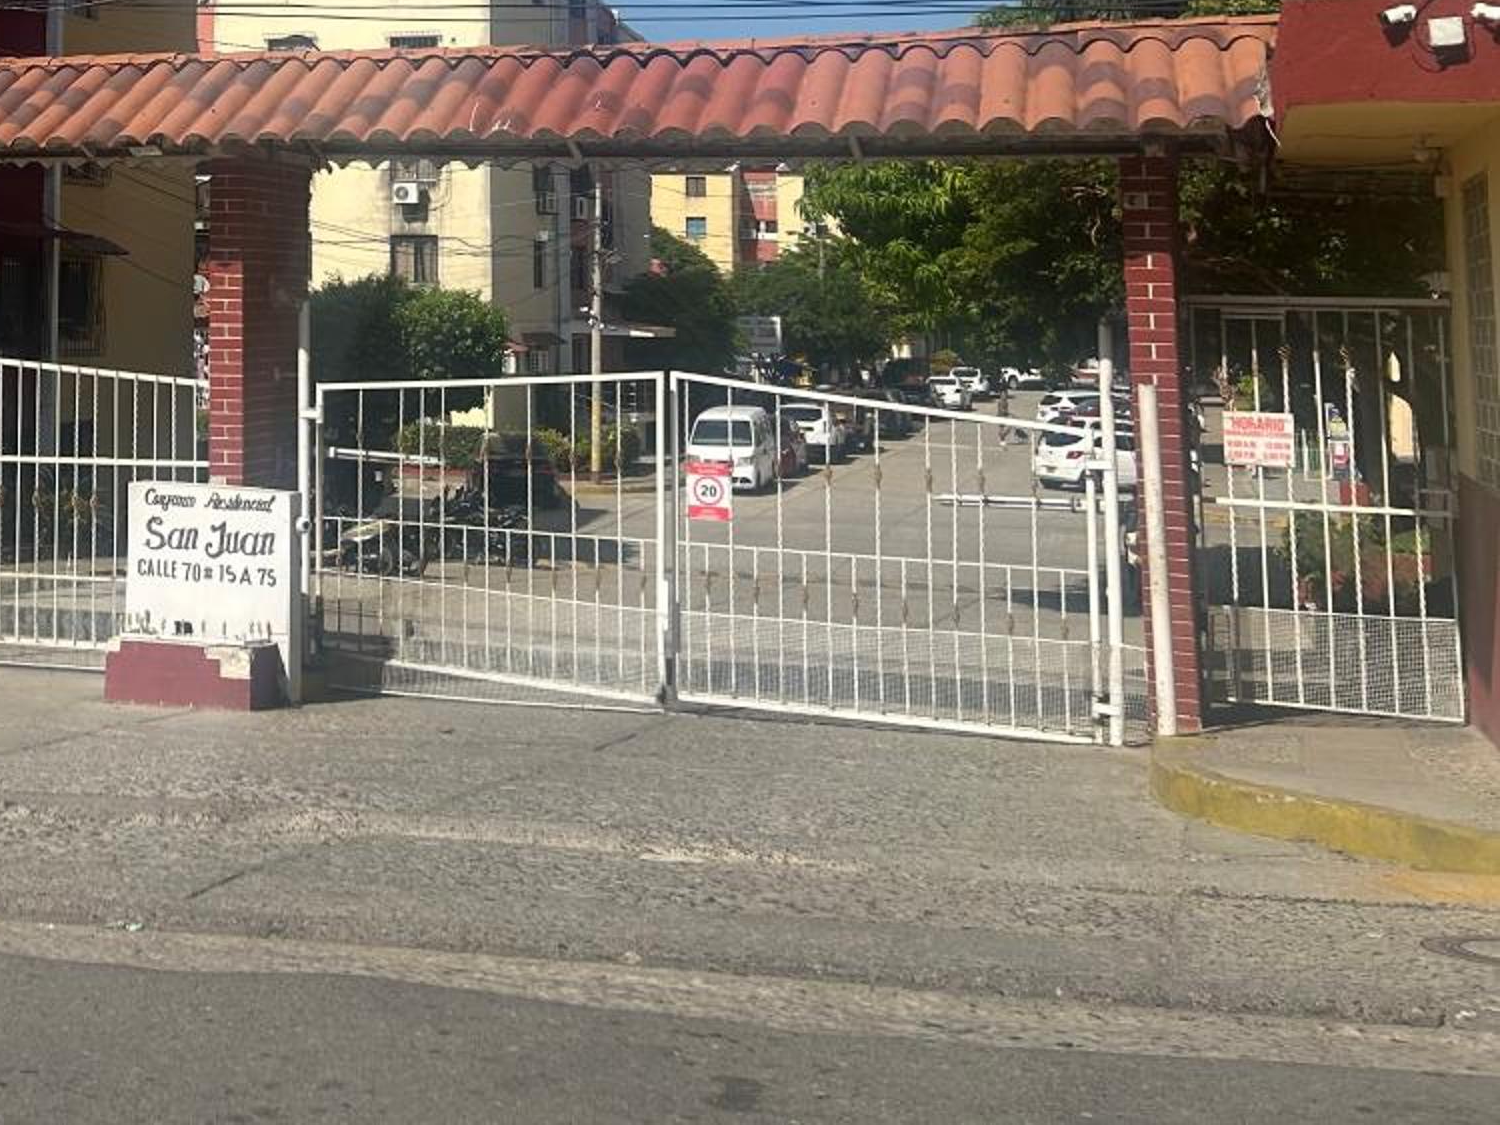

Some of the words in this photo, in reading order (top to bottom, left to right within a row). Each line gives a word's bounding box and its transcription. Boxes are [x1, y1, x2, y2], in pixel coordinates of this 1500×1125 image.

[700, 484, 717, 497] 20
[144, 515, 199, 550] San
[205, 521, 276, 558] Juan
[137, 558, 177, 579] CALLE
[181, 562, 201, 582] 70
[257, 567, 276, 587] 75
